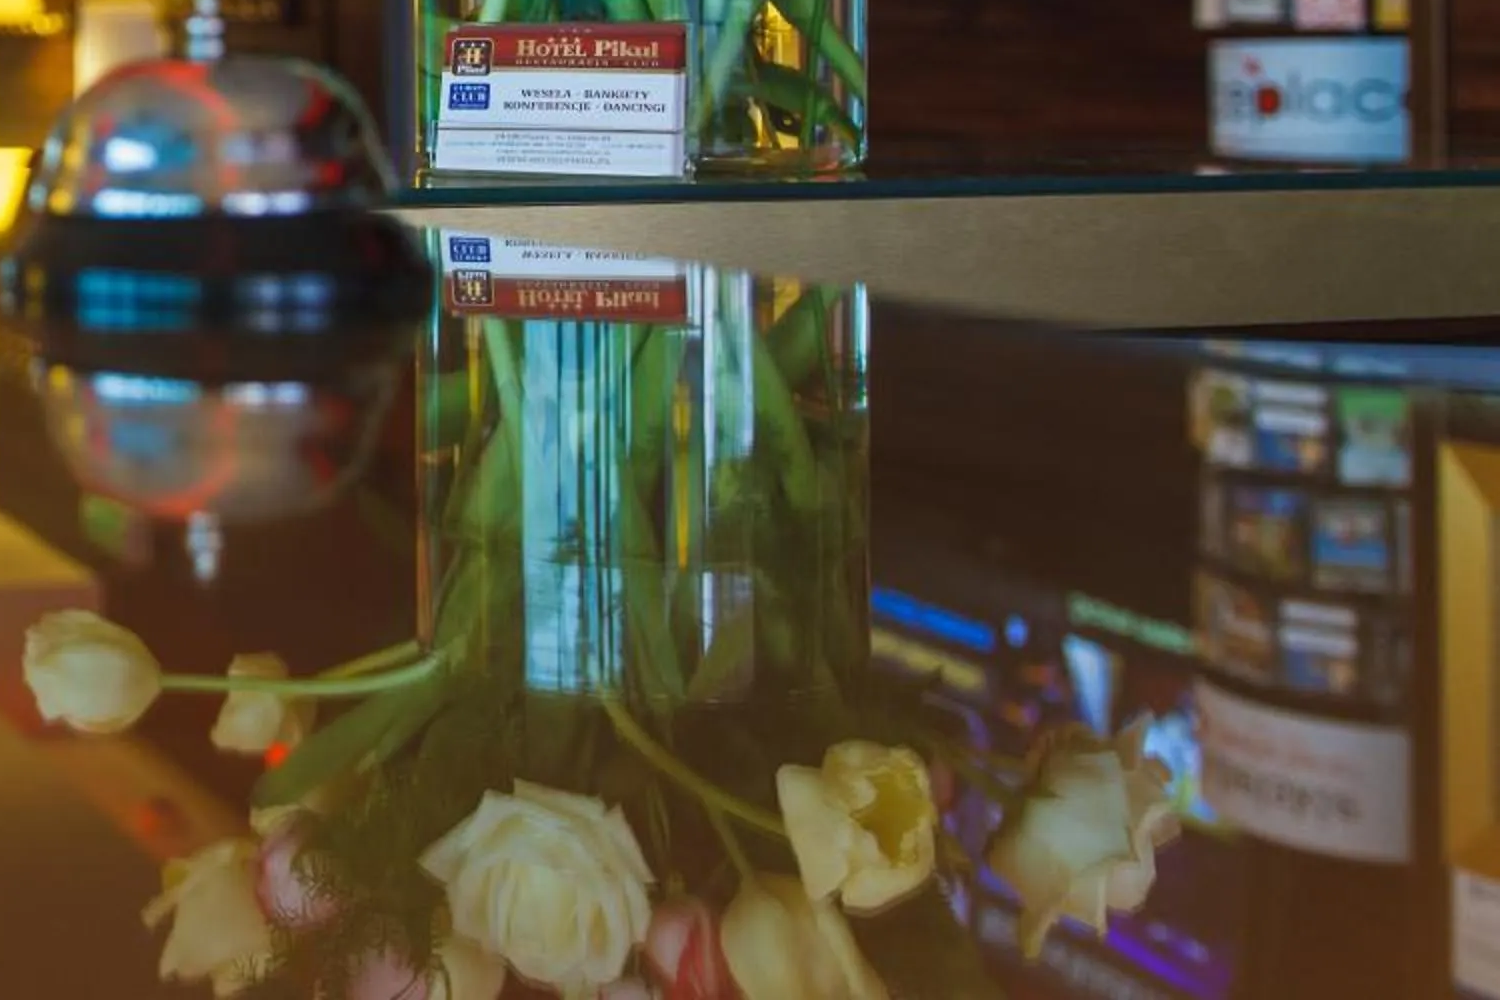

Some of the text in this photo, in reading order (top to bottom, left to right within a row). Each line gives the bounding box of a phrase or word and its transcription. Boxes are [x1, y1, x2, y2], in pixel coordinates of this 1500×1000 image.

[594, 39, 659, 58] Pikul
[521, 88, 651, 100] WESELA BANKIETY
[503, 101, 666, 114] KONFERENCJE DANCINGI
